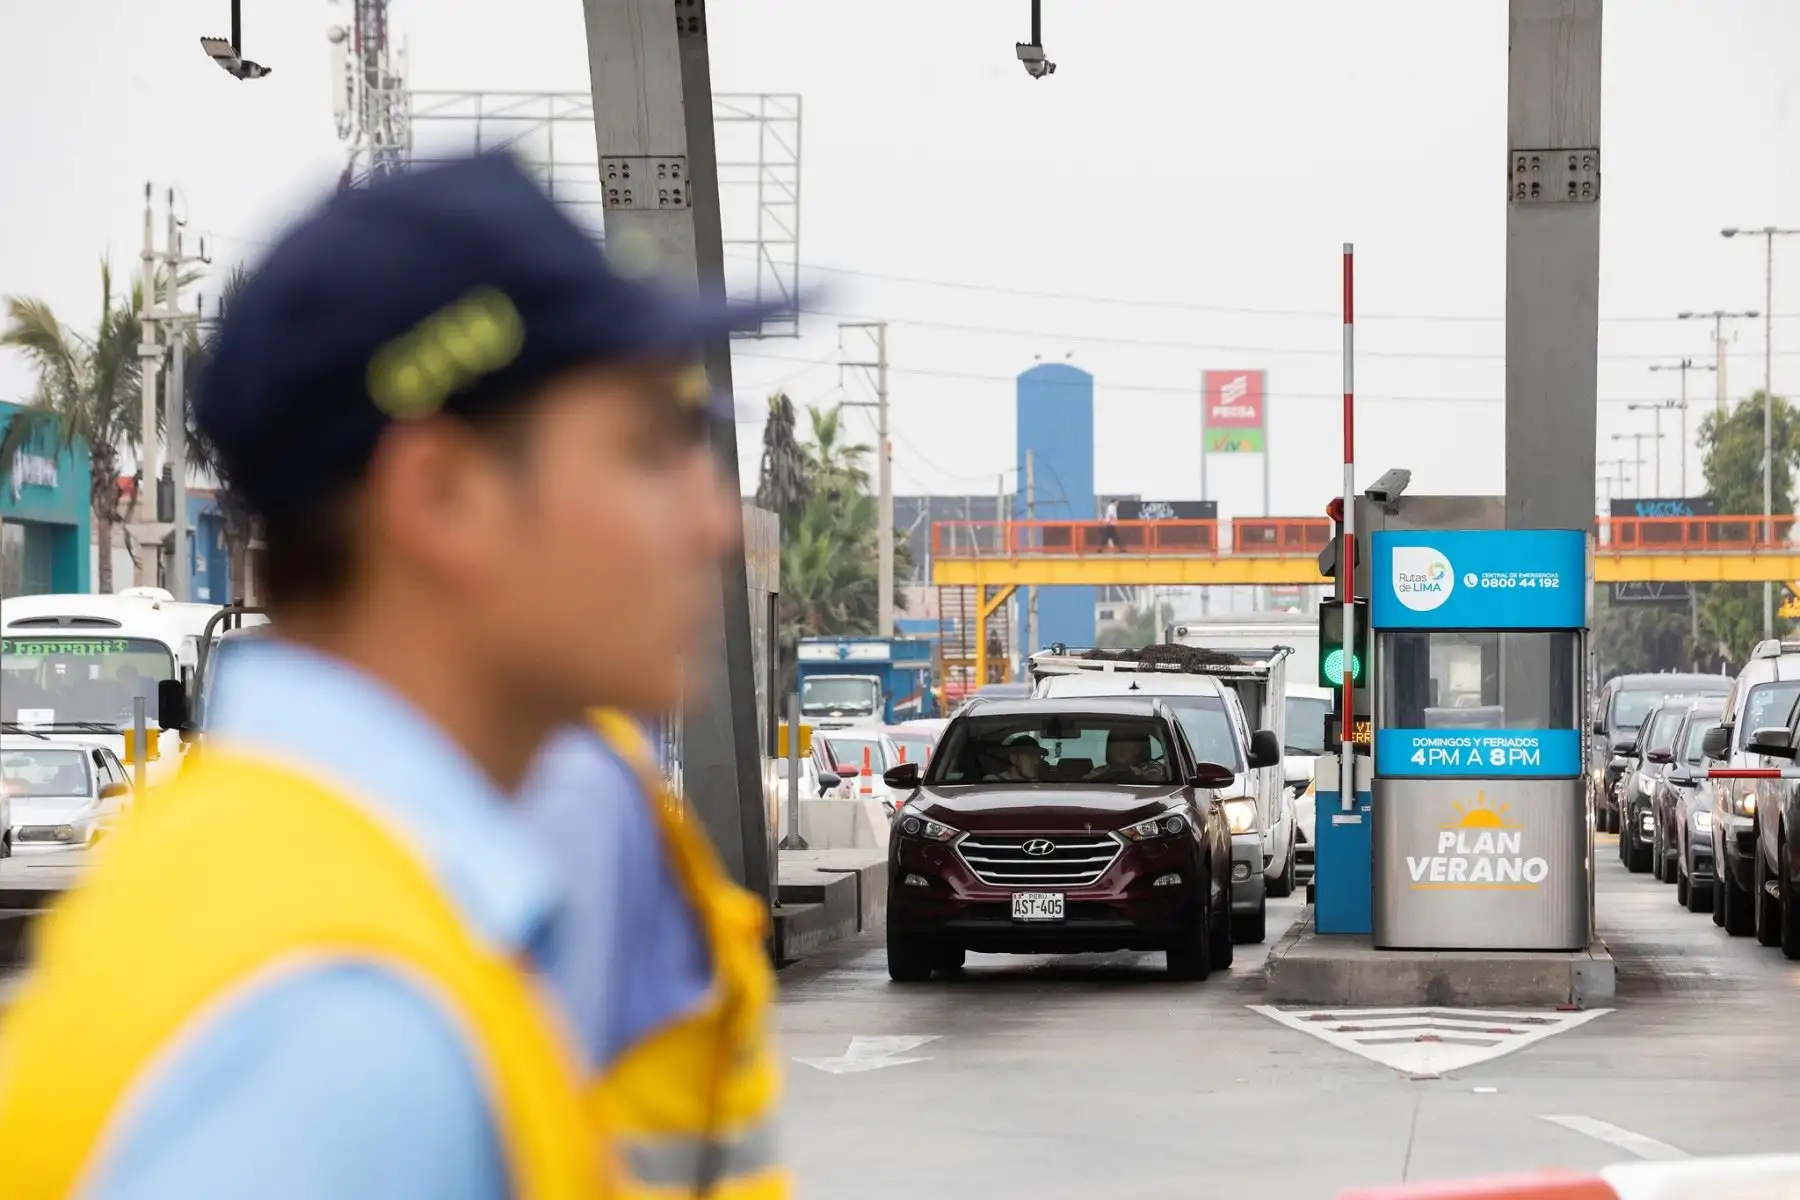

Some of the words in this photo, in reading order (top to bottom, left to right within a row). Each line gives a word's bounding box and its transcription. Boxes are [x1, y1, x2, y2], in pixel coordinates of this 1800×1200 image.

[1399, 573, 1428, 582] Rutas
[1481, 578, 1516, 588] 0800
[1519, 578, 1536, 588] 44
[1539, 578, 1559, 588] 192
[1399, 583, 1412, 592] de
[1413, 583, 1442, 592] LIMA
[14, 641, 112, 657] Ferrari
[1412, 737, 1471, 747] DOMINGOS
[1472, 737, 1482, 747] Y
[1482, 737, 1539, 747] FERIADOS
[1466, 748, 1484, 766] A
[1437, 831, 1522, 854] PLAN
[1406, 856, 1549, 883] VERANO
[1014, 899, 1062, 915] AST-405
